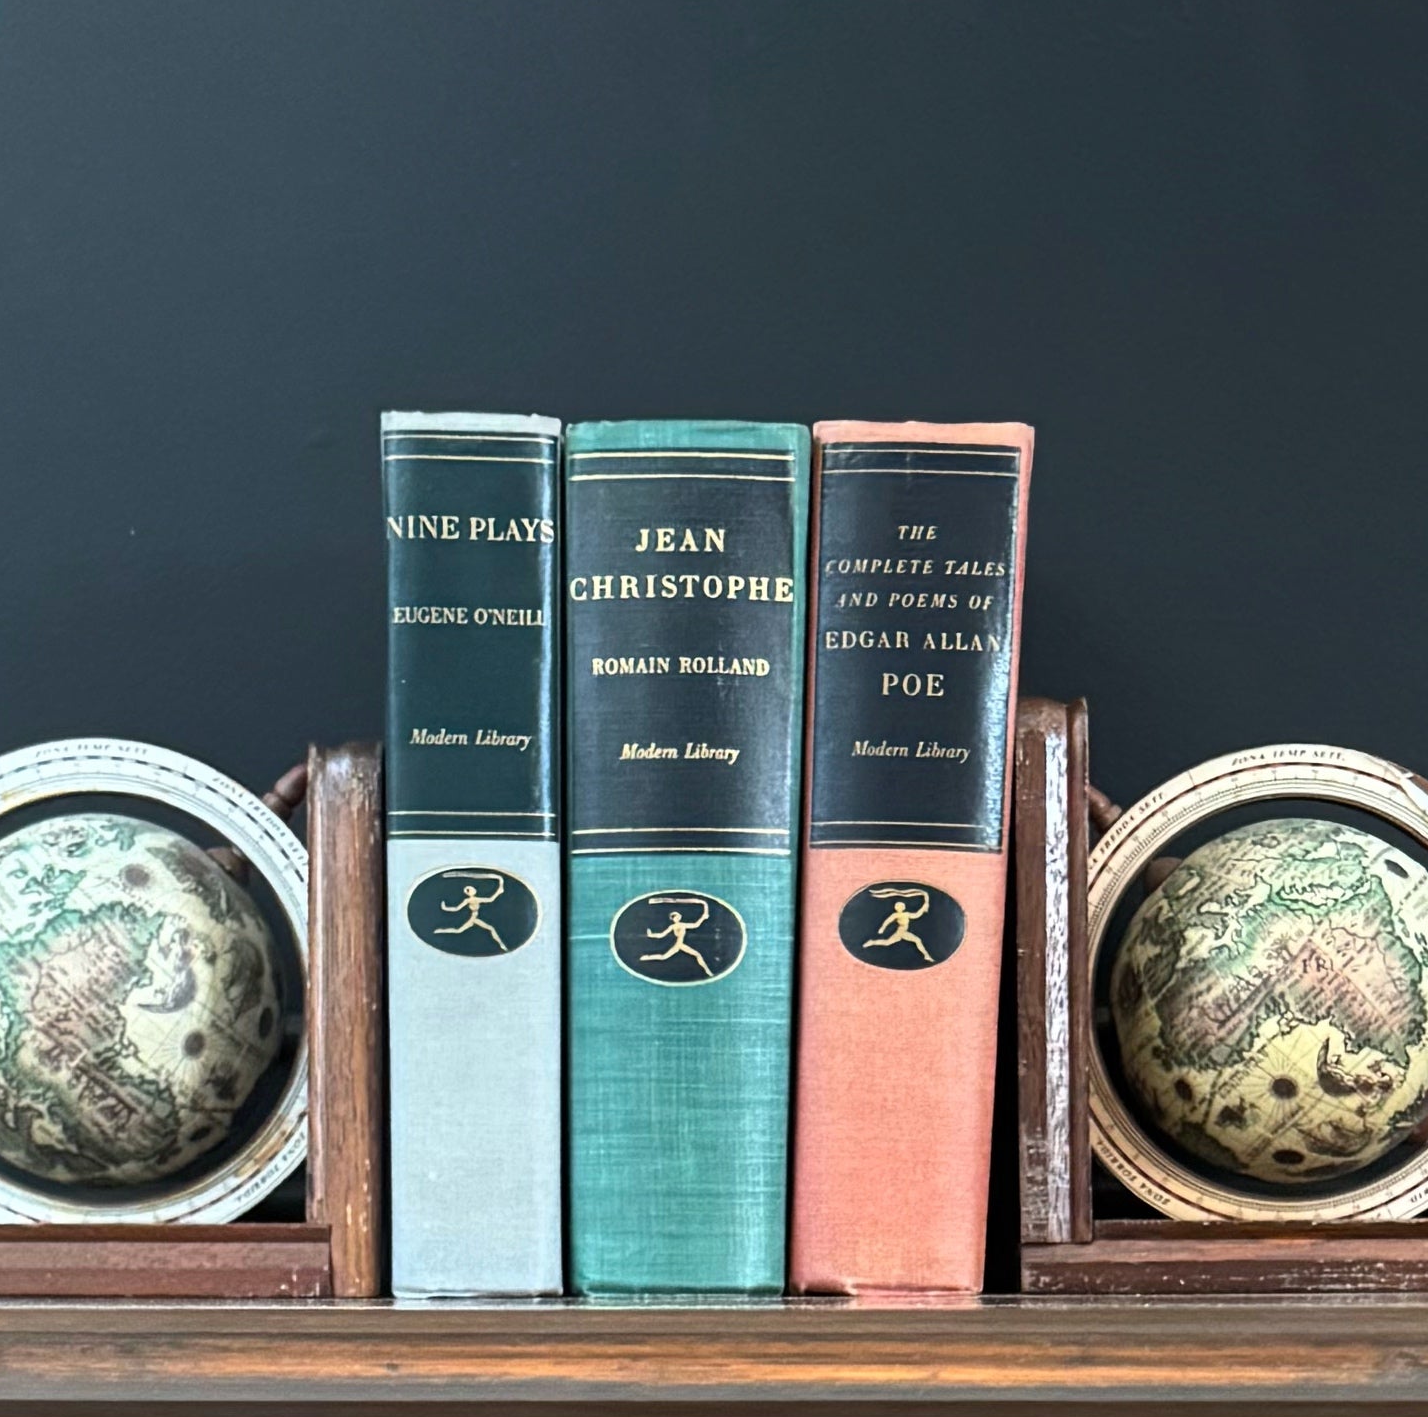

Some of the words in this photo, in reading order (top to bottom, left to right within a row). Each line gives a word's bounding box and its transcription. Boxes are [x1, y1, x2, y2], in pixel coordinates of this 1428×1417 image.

[387, 515, 460, 540] NINE
[469, 516, 555, 544] PLAYS
[635, 528, 726, 553] JEAN
[897, 525, 939, 541] THE
[825, 558, 935, 576] COMPLETE
[944, 559, 1006, 577] TALES
[570, 574, 794, 603] CHRISTOPHE
[836, 592, 878, 609] AND
[888, 593, 959, 610] POEMS
[968, 595, 995, 612] OF
[393, 606, 468, 625] EUGENE
[473, 608, 547, 626] O'NEILL
[825, 631, 910, 650] EDGAR
[923, 632, 1002, 652] ALLAN
[592, 657, 670, 676] ROMAIN
[679, 656, 770, 677] ROLLAND
[881, 672, 945, 697] POE
[410, 728, 468, 746] Modern
[475, 729, 533, 751] Library
[620, 743, 678, 761] Modern
[684, 743, 740, 765] Library
[851, 740, 909, 758] Modern
[915, 741, 971, 764] Library
